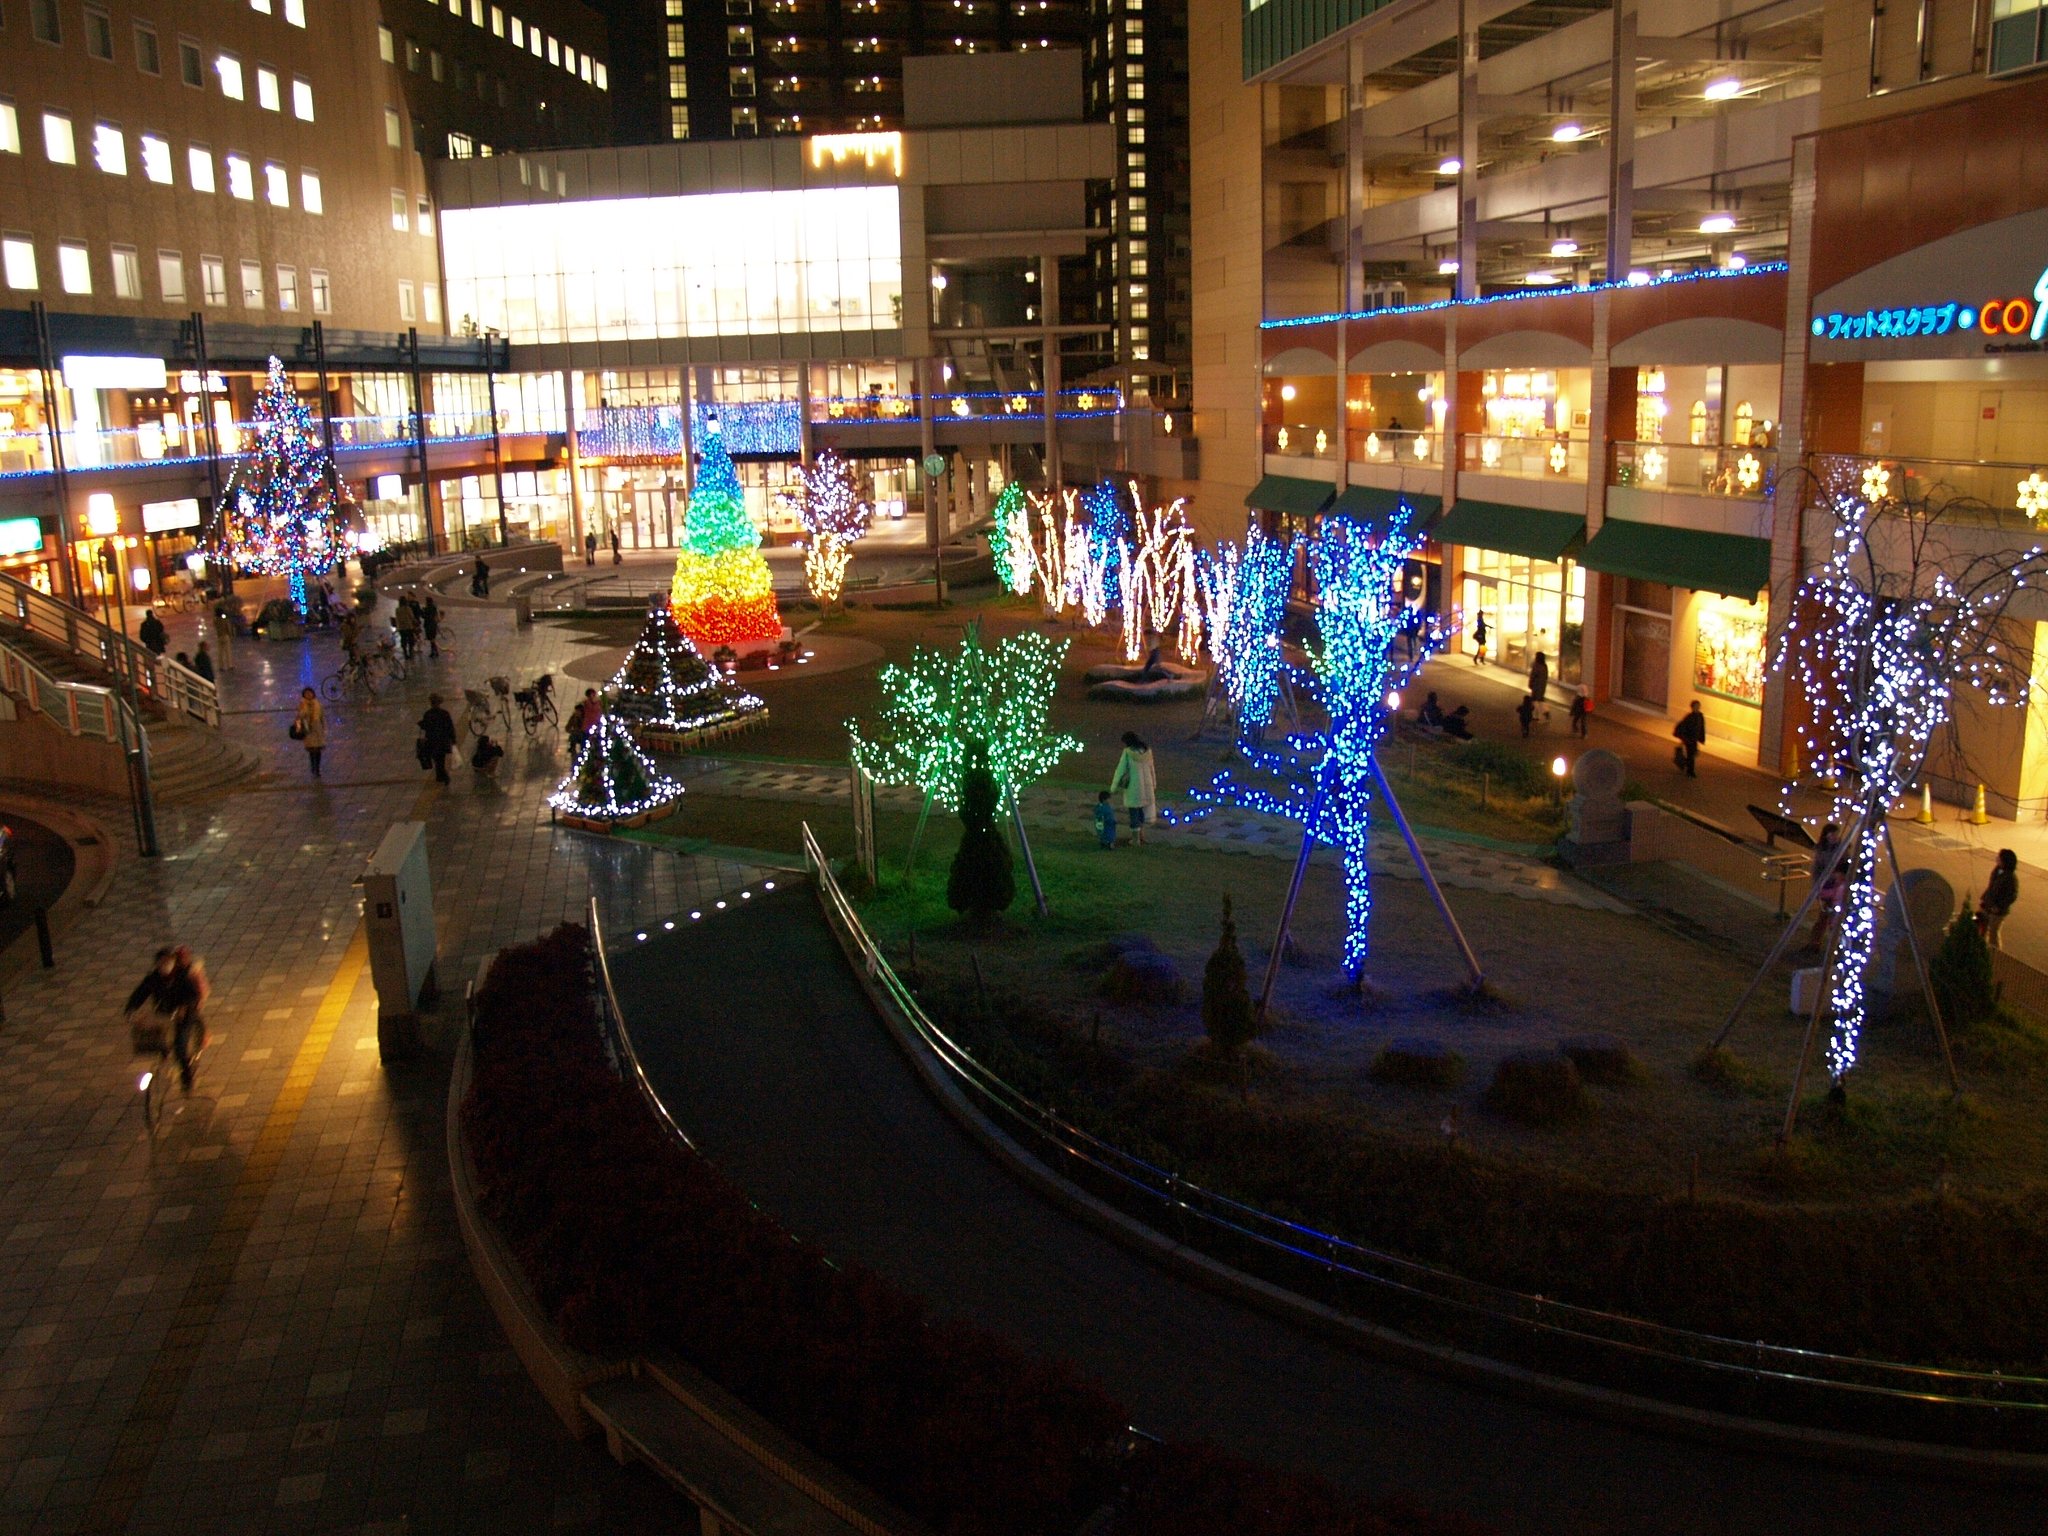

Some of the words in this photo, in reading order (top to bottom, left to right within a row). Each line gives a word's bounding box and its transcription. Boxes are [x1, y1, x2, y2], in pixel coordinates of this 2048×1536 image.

[1828, 302, 1957, 339] フィットネスクラブ
